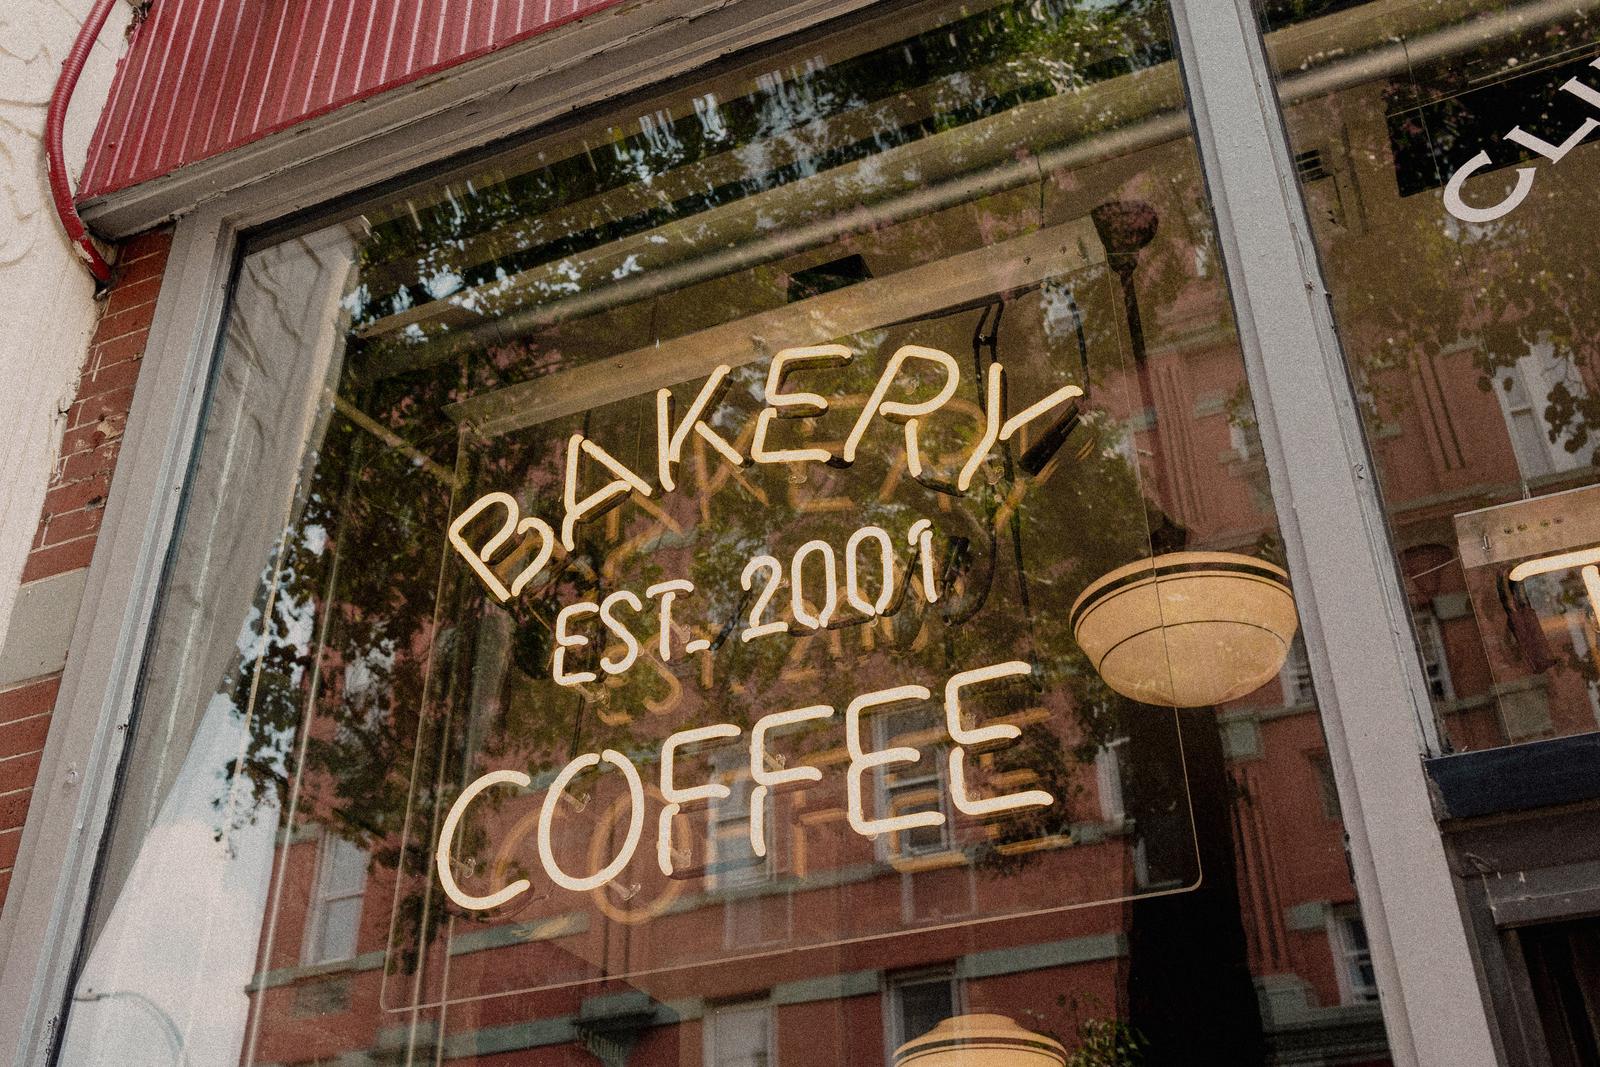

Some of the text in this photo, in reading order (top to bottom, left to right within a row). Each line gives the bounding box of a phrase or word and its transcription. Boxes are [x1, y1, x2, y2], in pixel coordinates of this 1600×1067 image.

[448, 343, 1084, 603] BAKERY
[741, 518, 939, 643] 2001
[436, 660, 1055, 911] COFFEE
